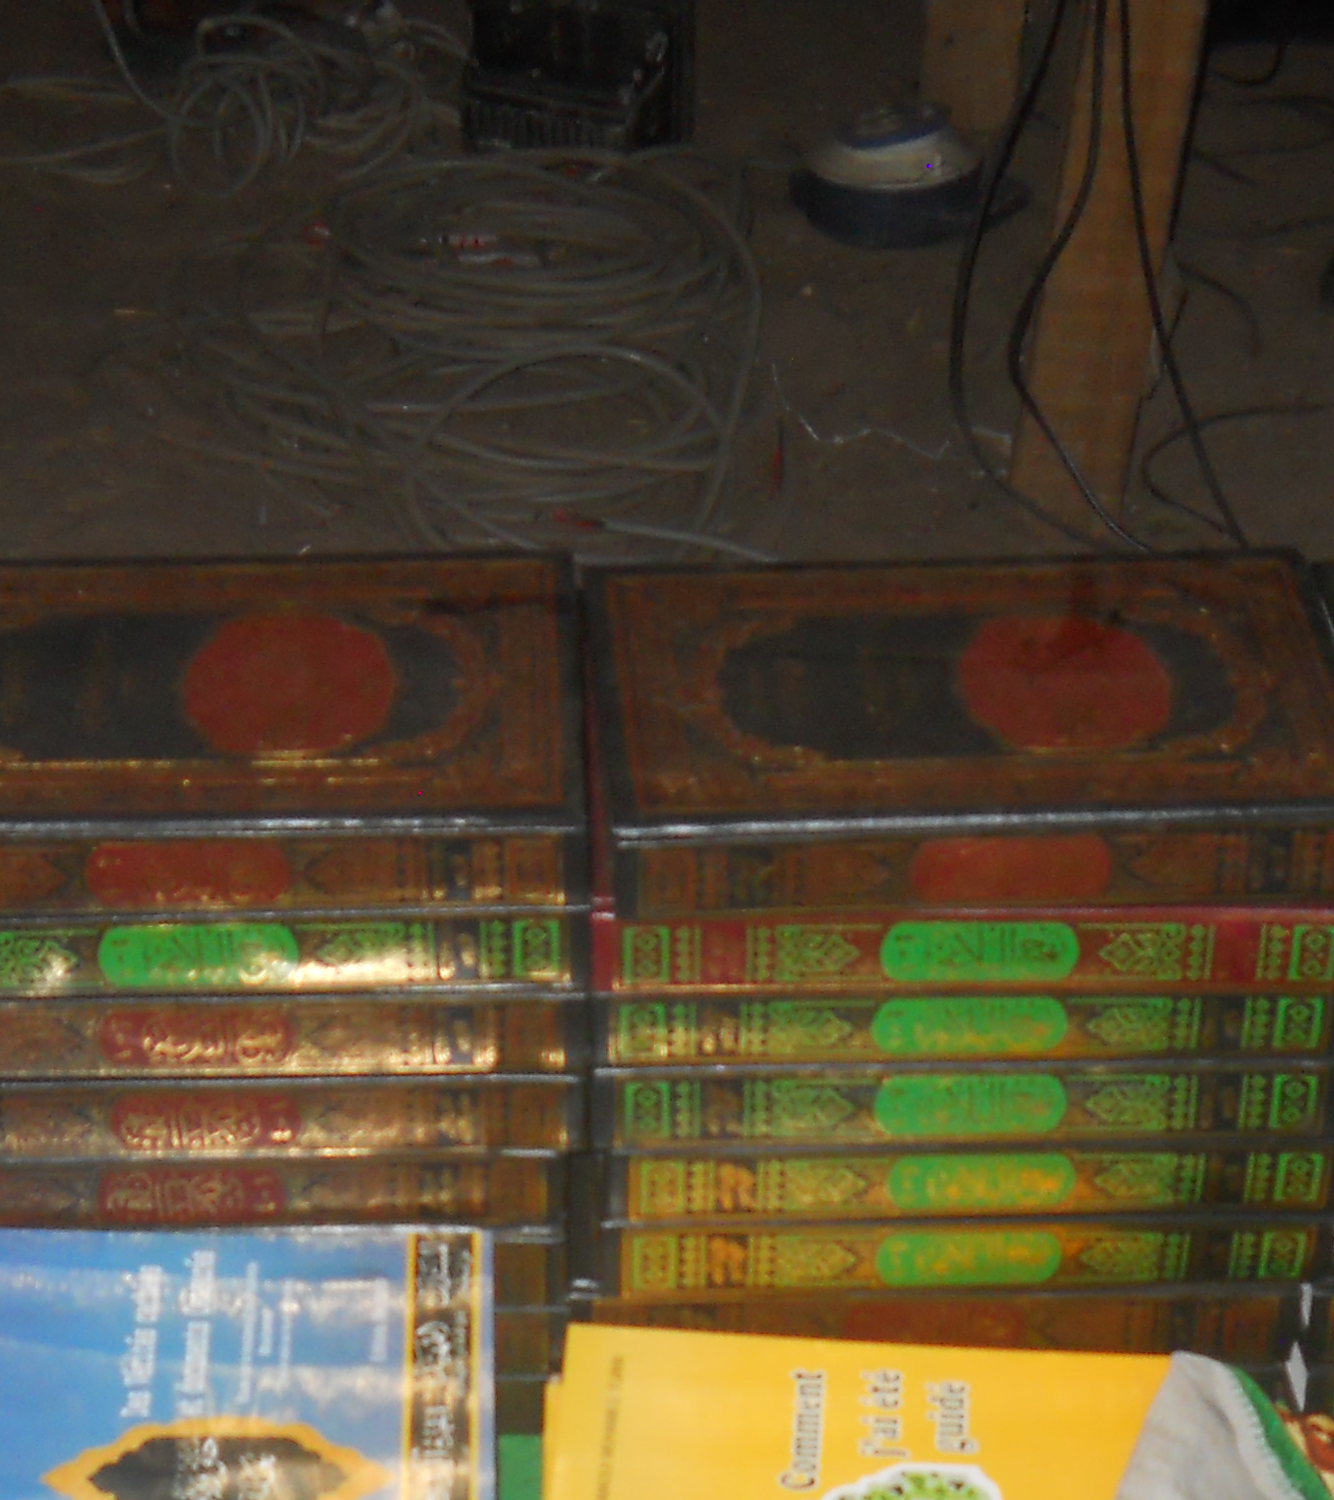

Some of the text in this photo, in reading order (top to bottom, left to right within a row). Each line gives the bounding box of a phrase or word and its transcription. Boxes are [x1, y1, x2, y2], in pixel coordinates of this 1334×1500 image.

[857, 1368, 905, 1411] été
[924, 1379, 980, 1455] guidé
[777, 1368, 826, 1491] Comment
